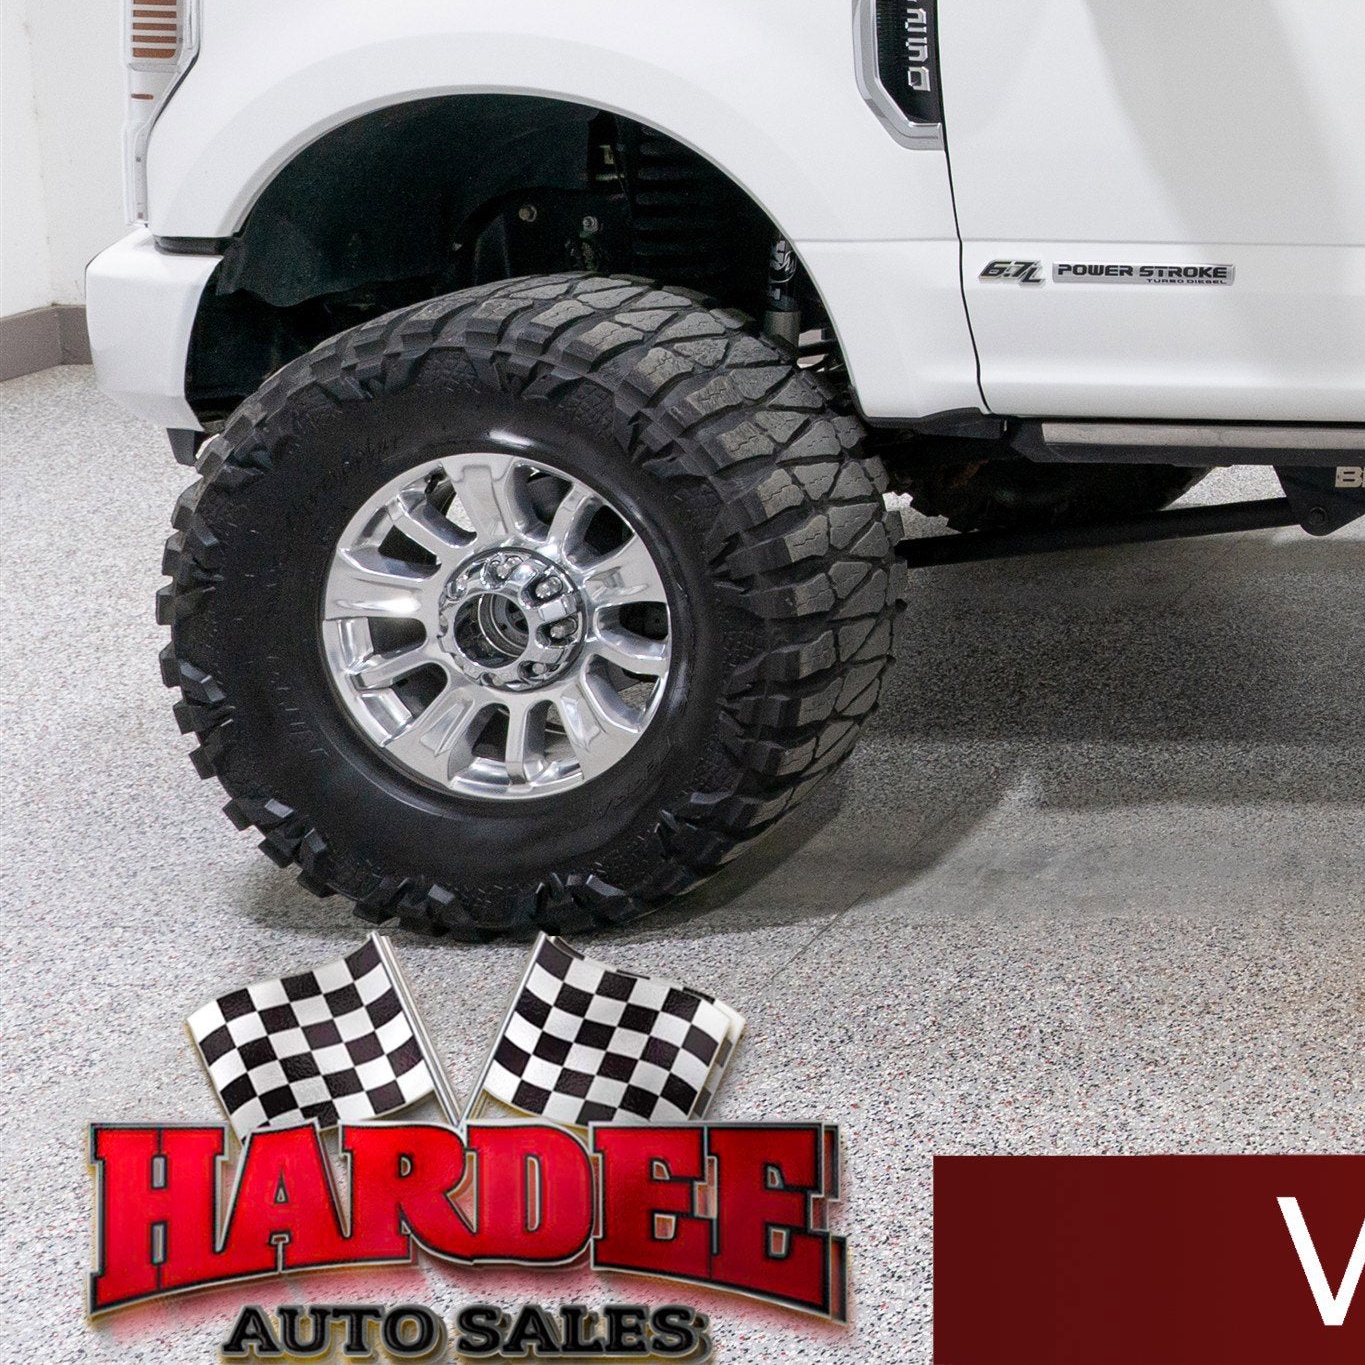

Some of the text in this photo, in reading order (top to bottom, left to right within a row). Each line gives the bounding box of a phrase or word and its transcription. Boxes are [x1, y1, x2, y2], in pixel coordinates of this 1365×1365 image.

[979, 259, 1046, 286] 6.7L
[1057, 263, 1228, 279] POWER STROKE
